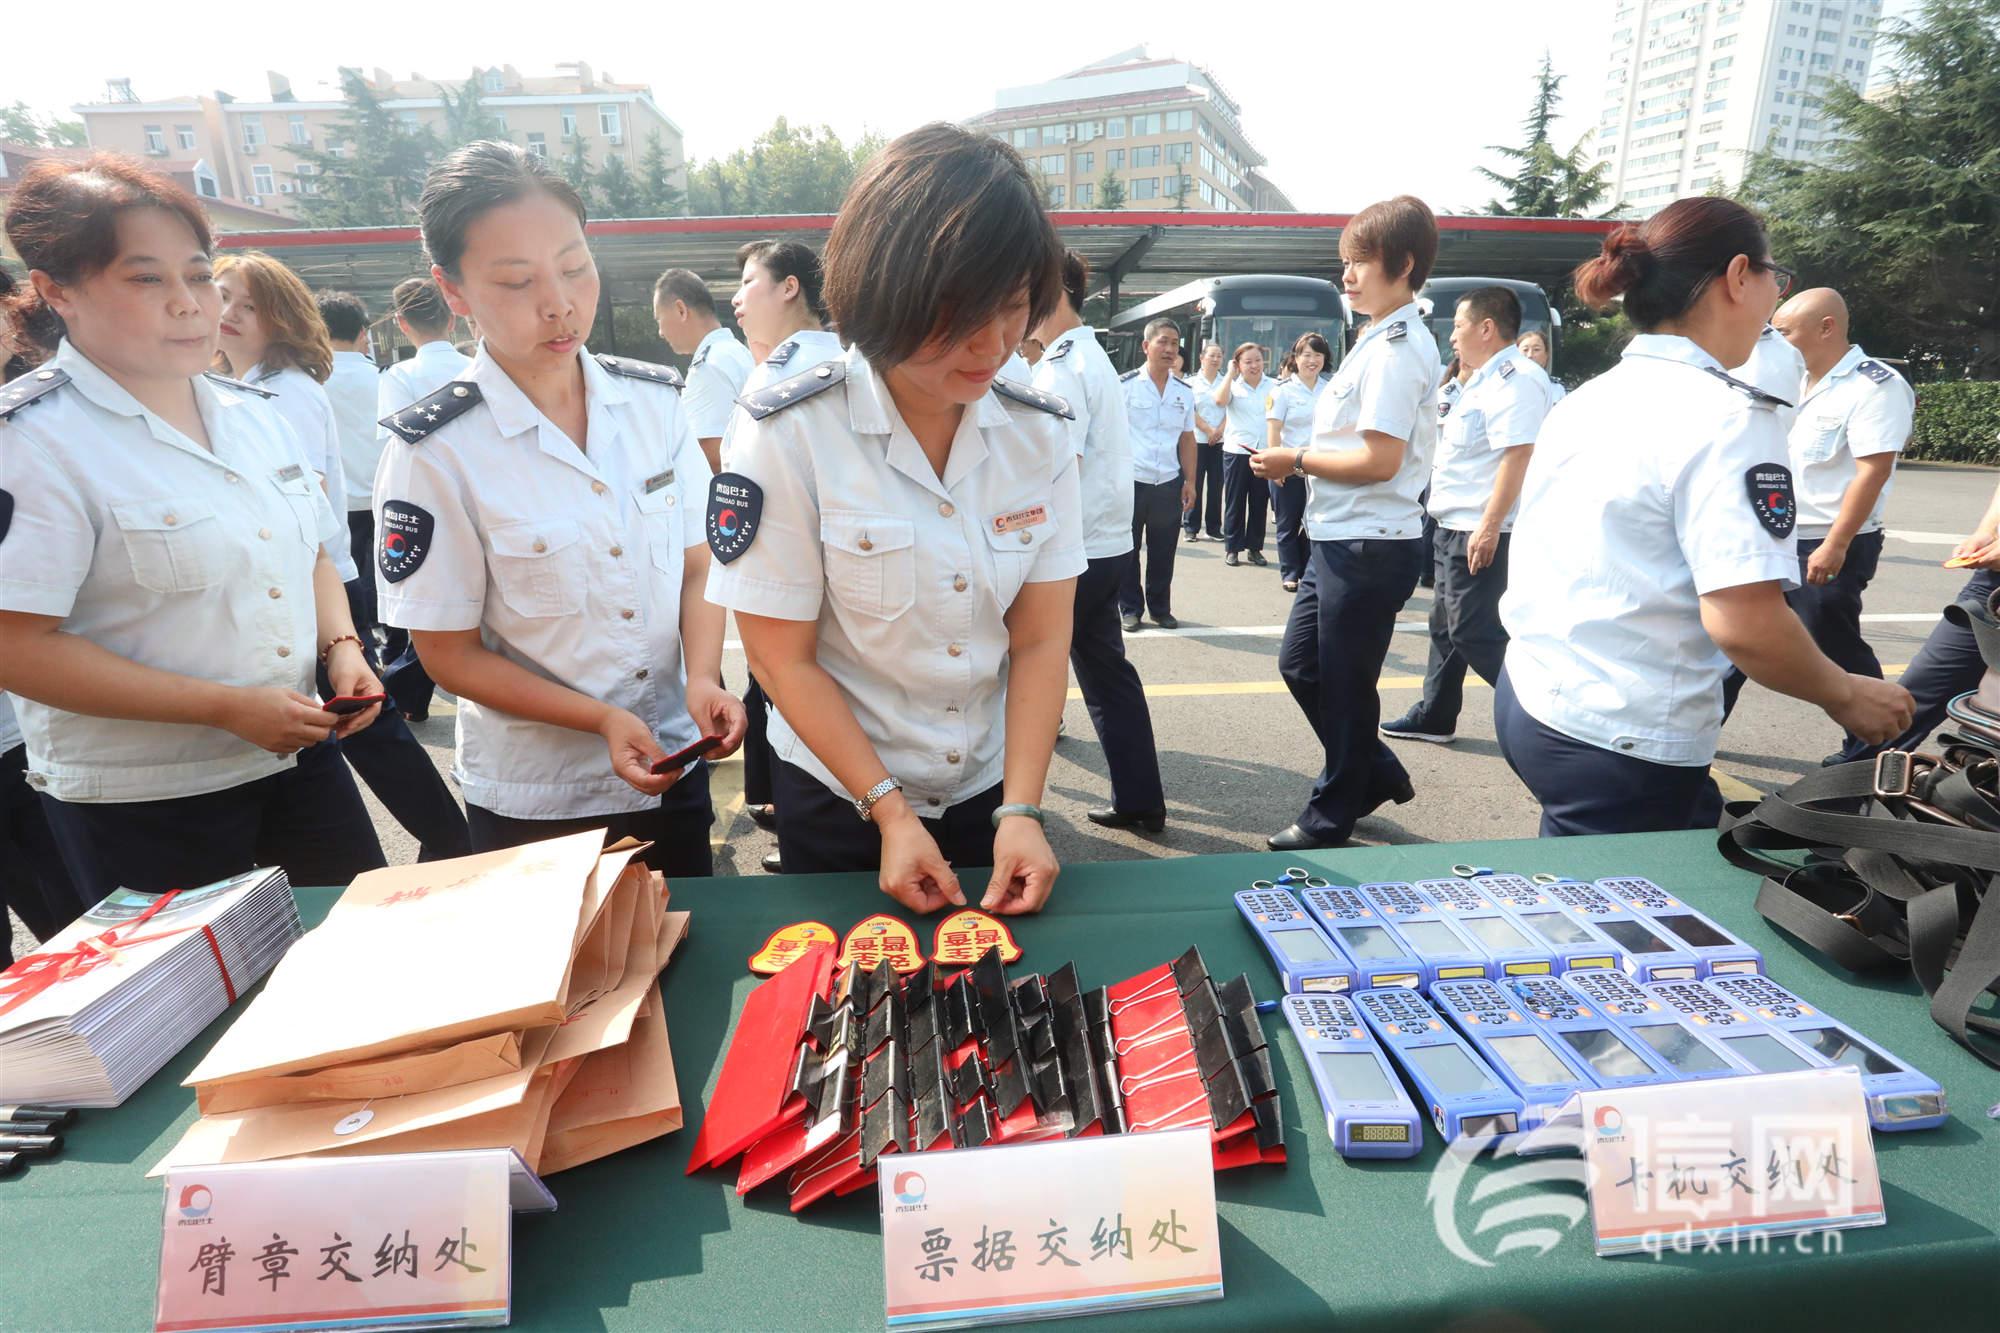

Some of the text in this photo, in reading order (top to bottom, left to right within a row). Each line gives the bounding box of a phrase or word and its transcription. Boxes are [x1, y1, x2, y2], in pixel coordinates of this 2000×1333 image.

[716, 483, 750, 498] 青岛巴士
[1616, 1143, 1858, 1205] 卡机交纳处
[188, 1227, 486, 1296] 臂章交纳处
[915, 1209, 1199, 1282] 票据交纳处
